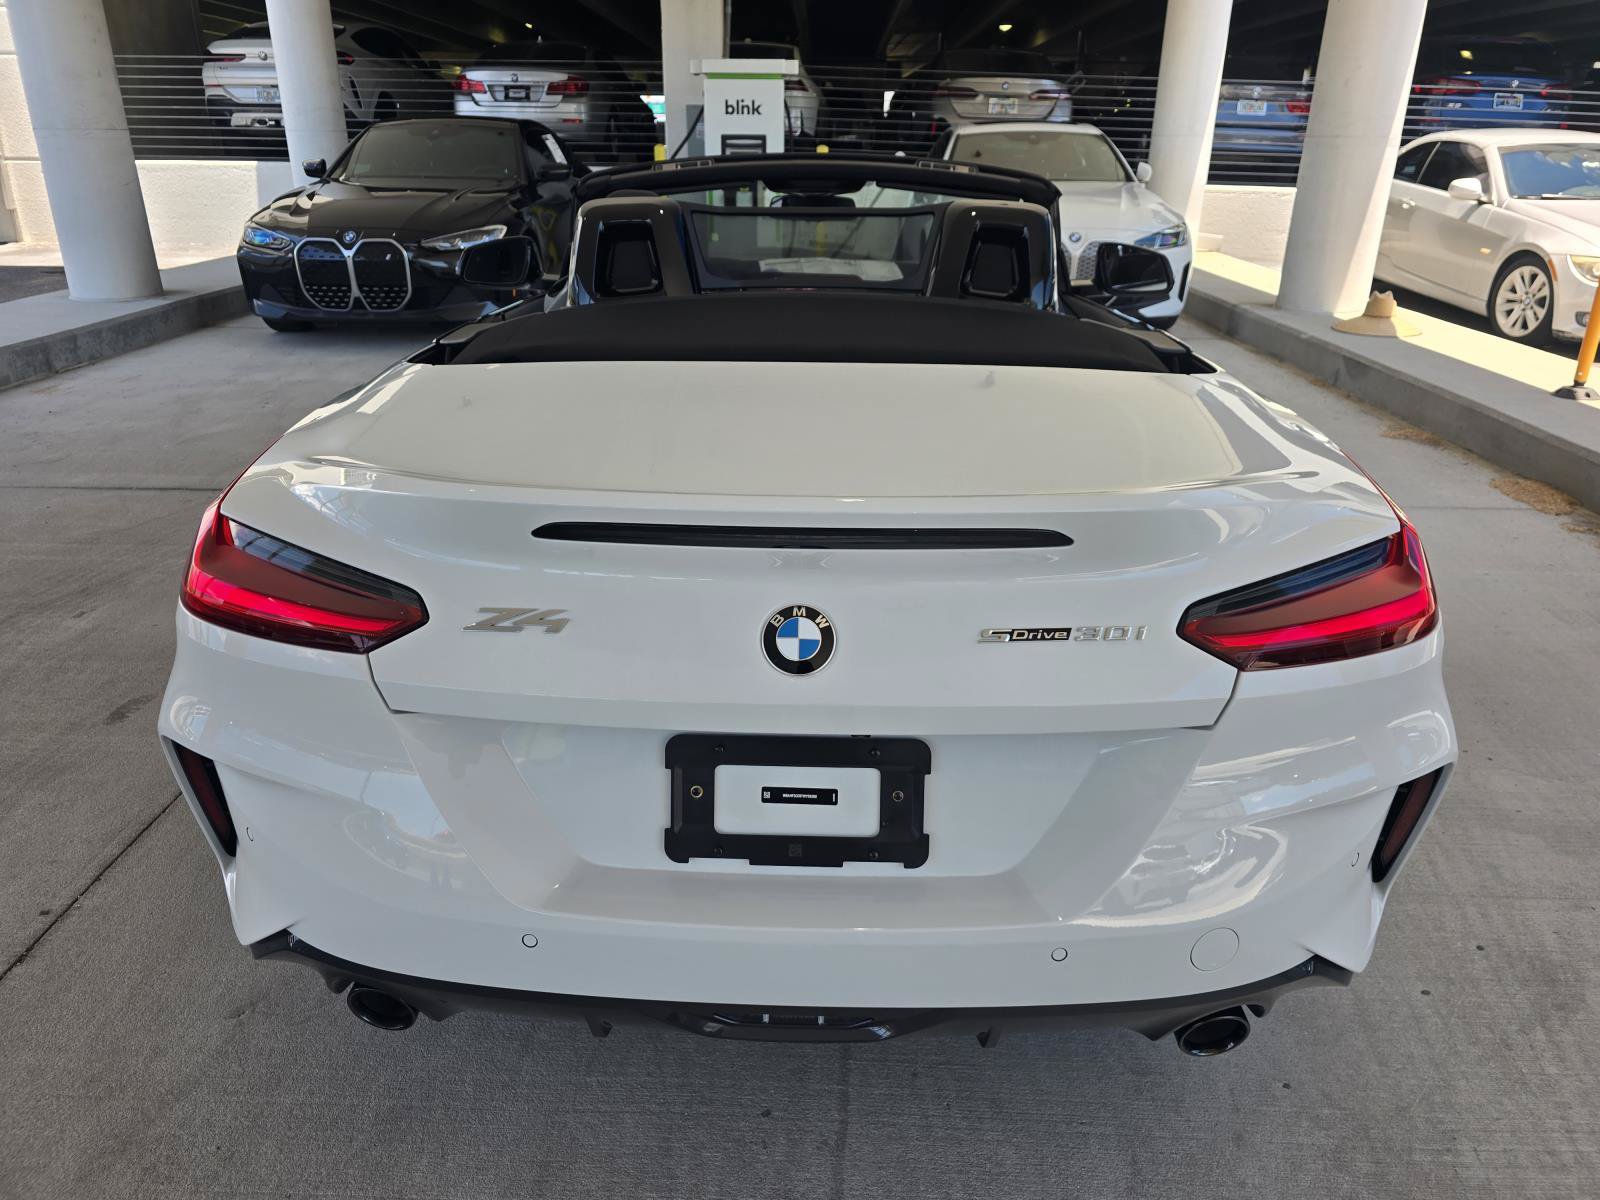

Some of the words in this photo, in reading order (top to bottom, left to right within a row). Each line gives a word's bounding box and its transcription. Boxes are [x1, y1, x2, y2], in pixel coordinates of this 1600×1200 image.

[725, 99, 762, 115] blink
[462, 607, 570, 634] Z4
[769, 606, 830, 629] BMW
